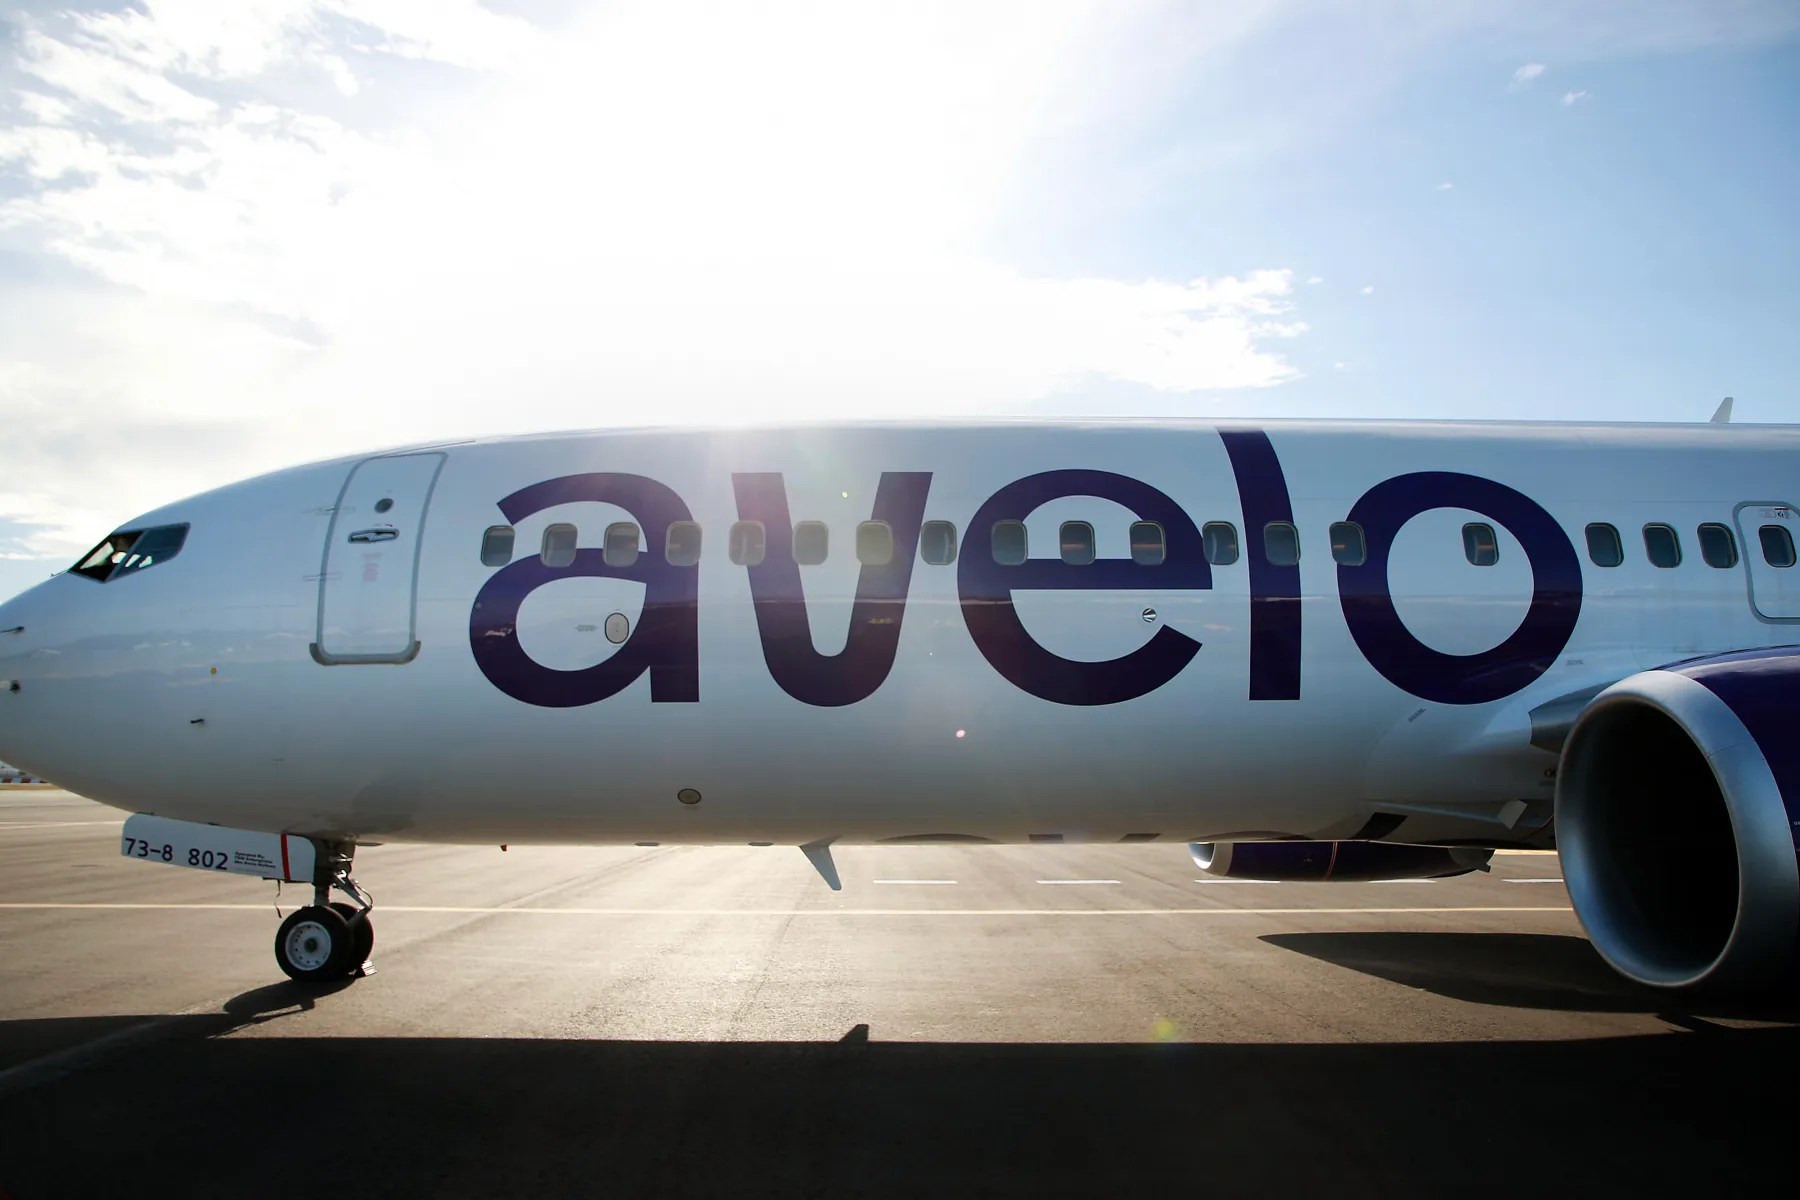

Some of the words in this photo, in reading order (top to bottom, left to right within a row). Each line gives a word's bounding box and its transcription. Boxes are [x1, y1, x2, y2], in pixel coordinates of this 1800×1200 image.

[470, 429, 1583, 708] avelo
[125, 837, 173, 862] 73-8
[187, 847, 229, 871] 802
